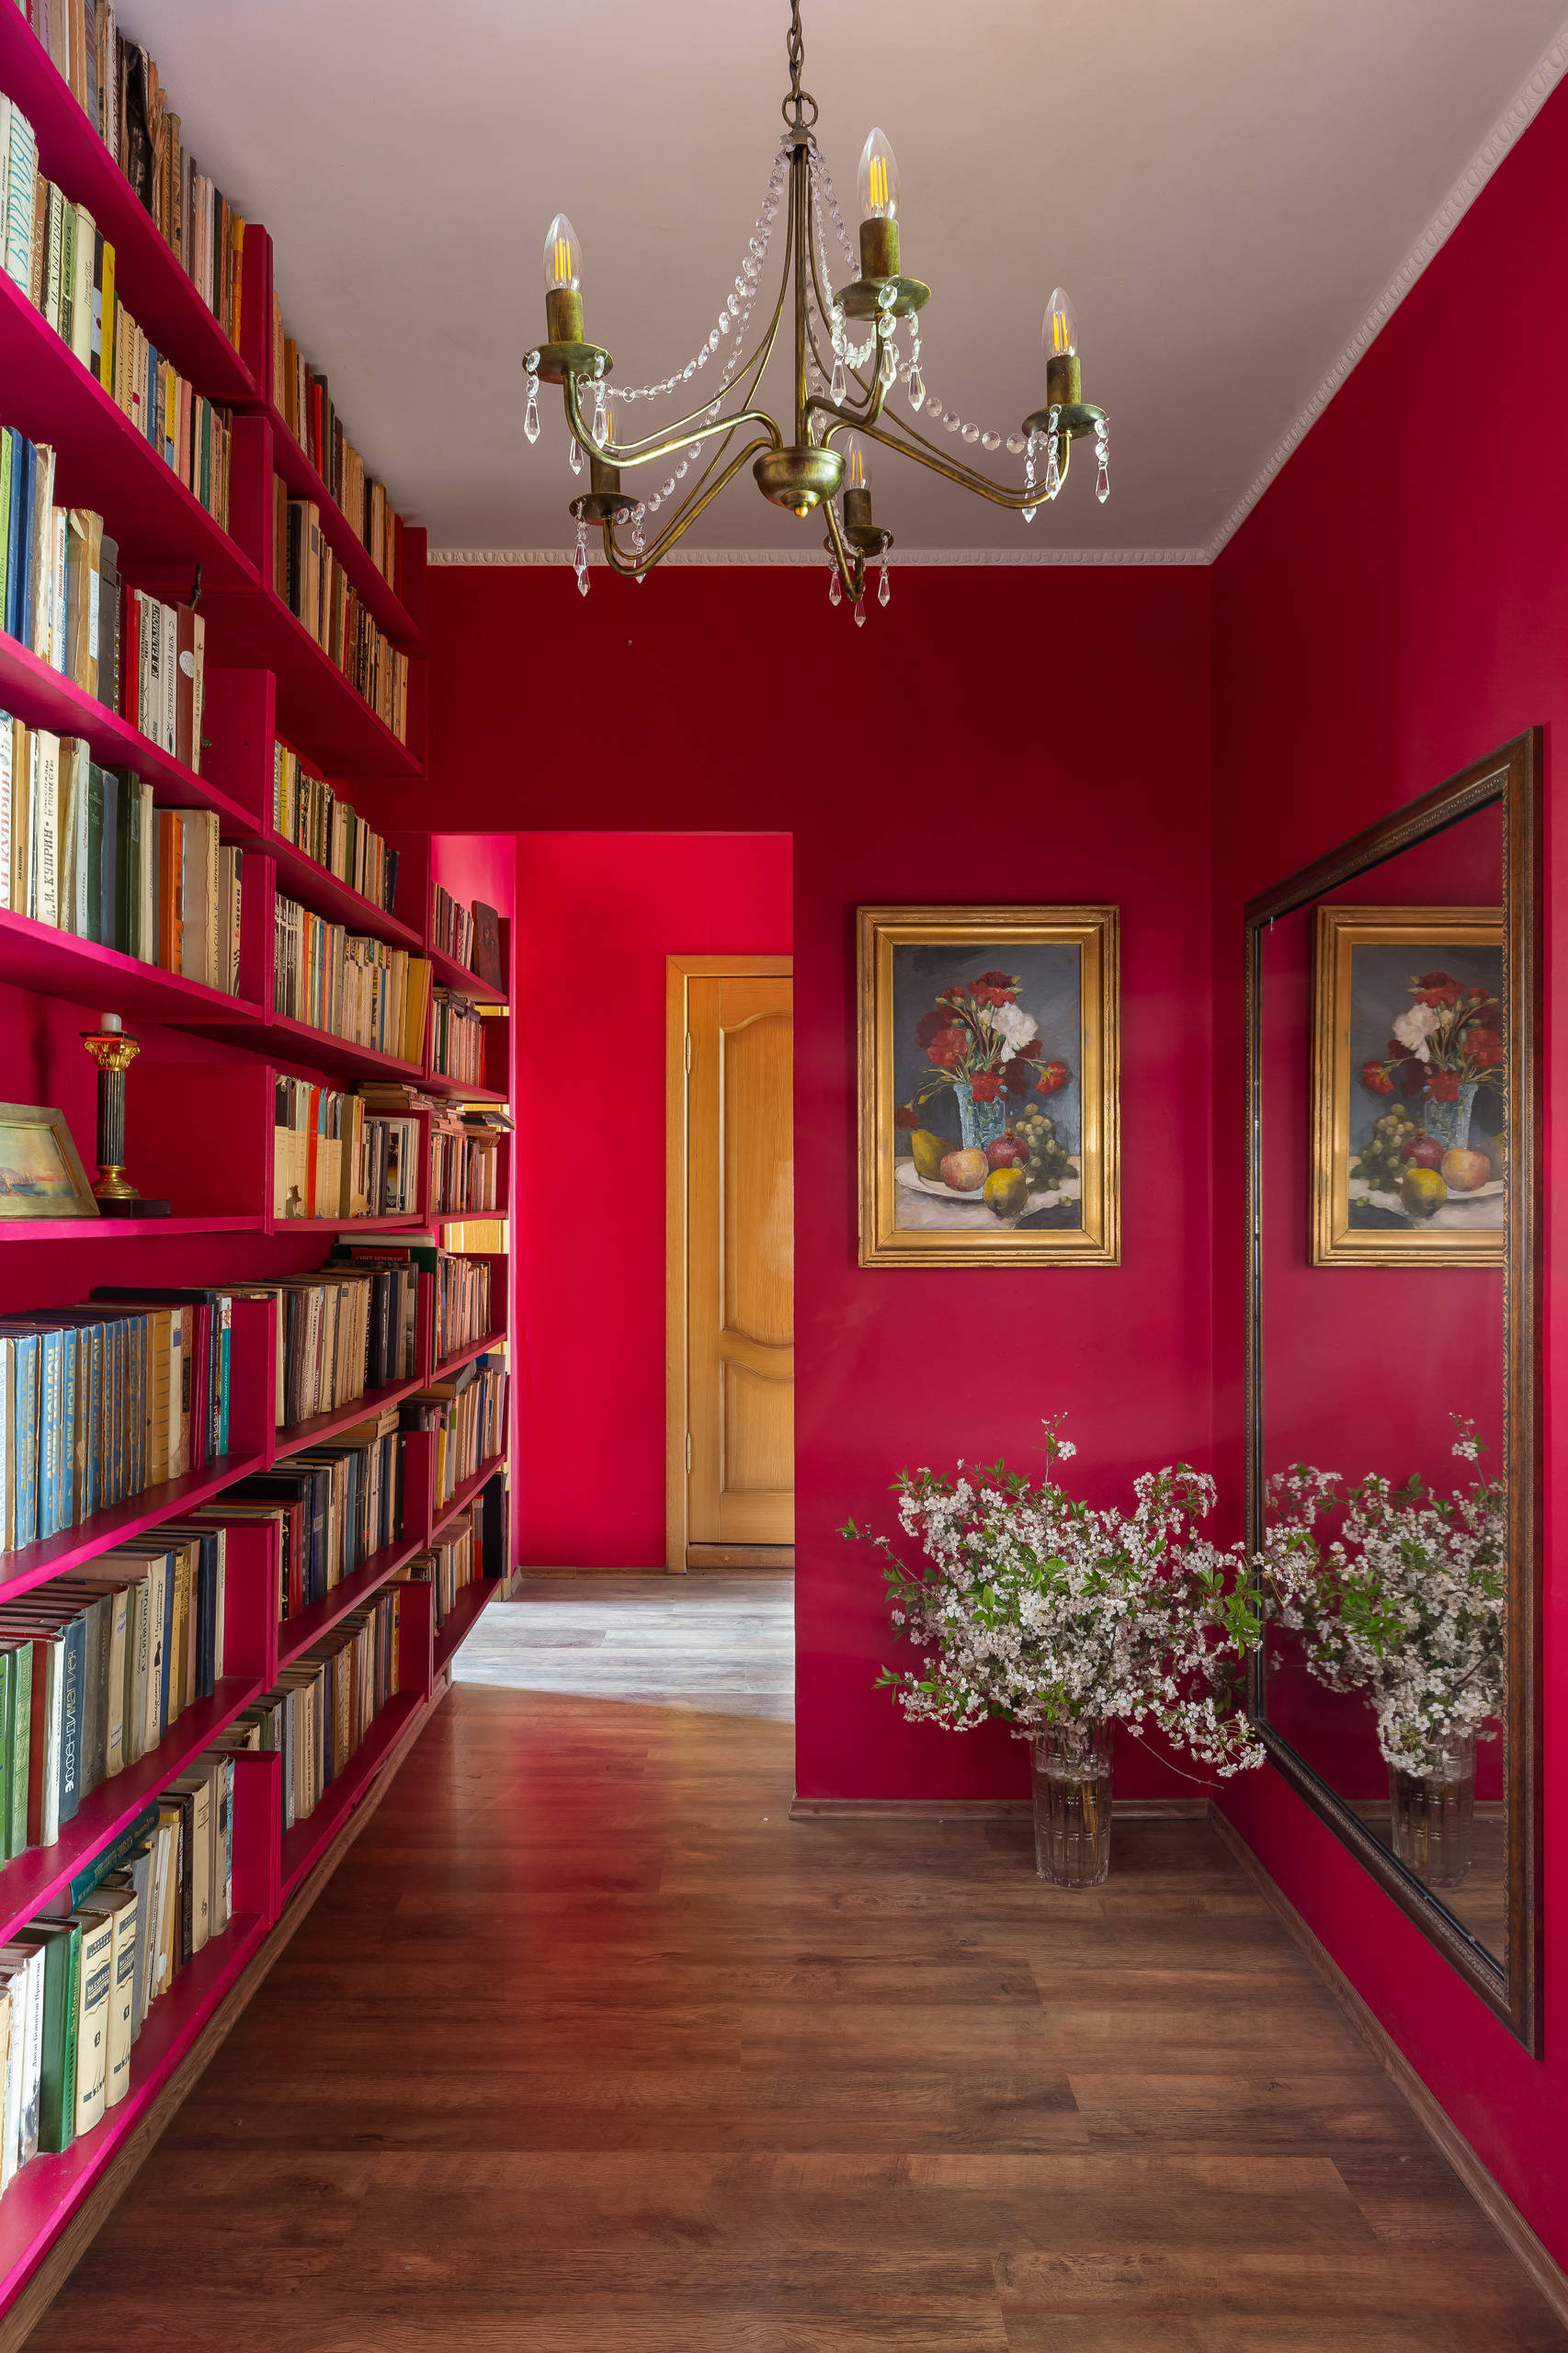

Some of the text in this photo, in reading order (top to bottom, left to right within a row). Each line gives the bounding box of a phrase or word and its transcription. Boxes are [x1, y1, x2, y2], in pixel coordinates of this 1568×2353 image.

[152, 605, 160, 656] БАЛЬМОНТ
[0, 770, 9, 863] КУПРИН
[43, 828, 53, 885] КУПРИН
